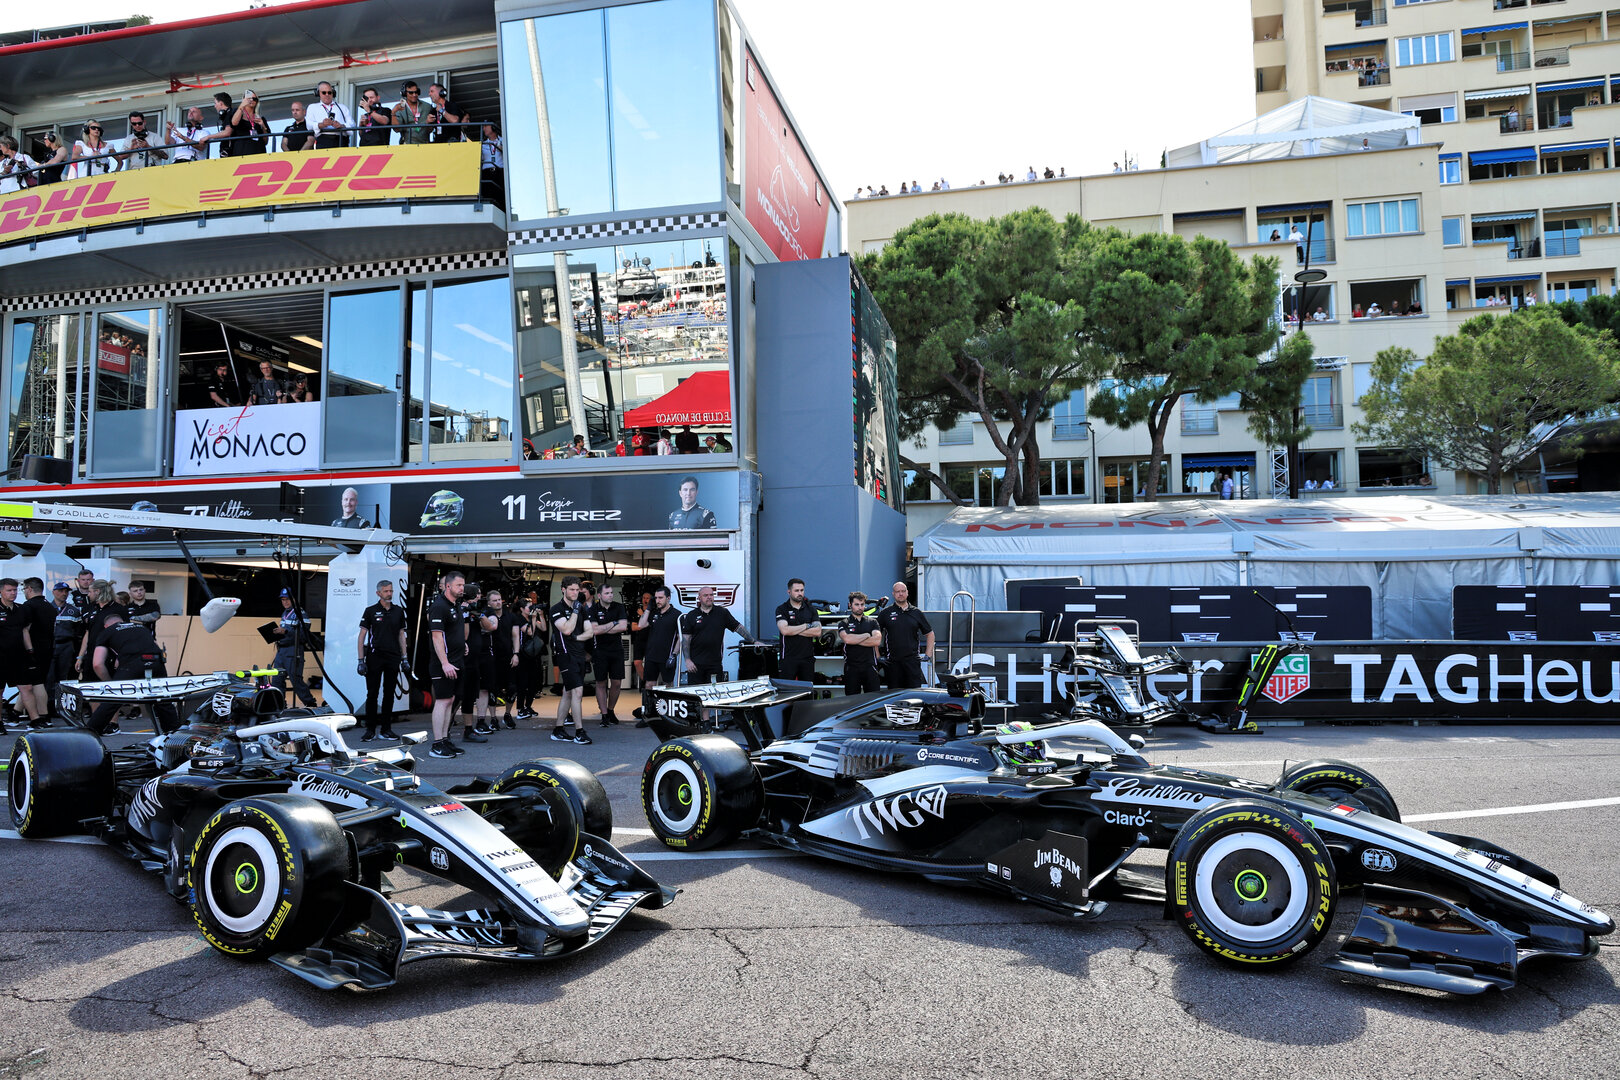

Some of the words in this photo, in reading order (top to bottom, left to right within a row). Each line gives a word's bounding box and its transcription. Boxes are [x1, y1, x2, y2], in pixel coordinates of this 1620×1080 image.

[230, 153, 402, 200] DHL
[0, 180, 124, 234] DHL
[193, 405, 254, 444] Visit
[190, 432, 306, 460] MONACO
[214, 499, 253, 518] Valtteri
[501, 494, 526, 520] 11
[538, 491, 574, 511] Sergio
[57, 509, 110, 519] CADILLAC
[540, 510, 621, 522] PEREZ
[964, 515, 1407, 533] MONACO
[79, 677, 218, 696] CADILLAC
[1267, 677, 1309, 701] EUER
[668, 699, 688, 718] IFS
[660, 744, 693, 758] ZERO
[928, 752, 945, 760] CORE
[945, 754, 979, 765] SCIENTIFIC
[513, 768, 525, 779] P
[1043, 766, 1053, 774] IFS
[298, 772, 351, 799] Cadillac
[1107, 777, 1204, 804] Cadillac
[1104, 809, 1146, 827] Claro
[190, 812, 222, 868] ZERO
[604, 855, 630, 871] SCIENTIFIC
[1033, 849, 1052, 868] JIM
[1052, 848, 1081, 880] BEAM
[1176, 860, 1188, 906] PIRELLI
[1301, 842, 1319, 856] P
[1313, 861, 1331, 932] ZERO
[265, 899, 292, 941] PIRELLI
